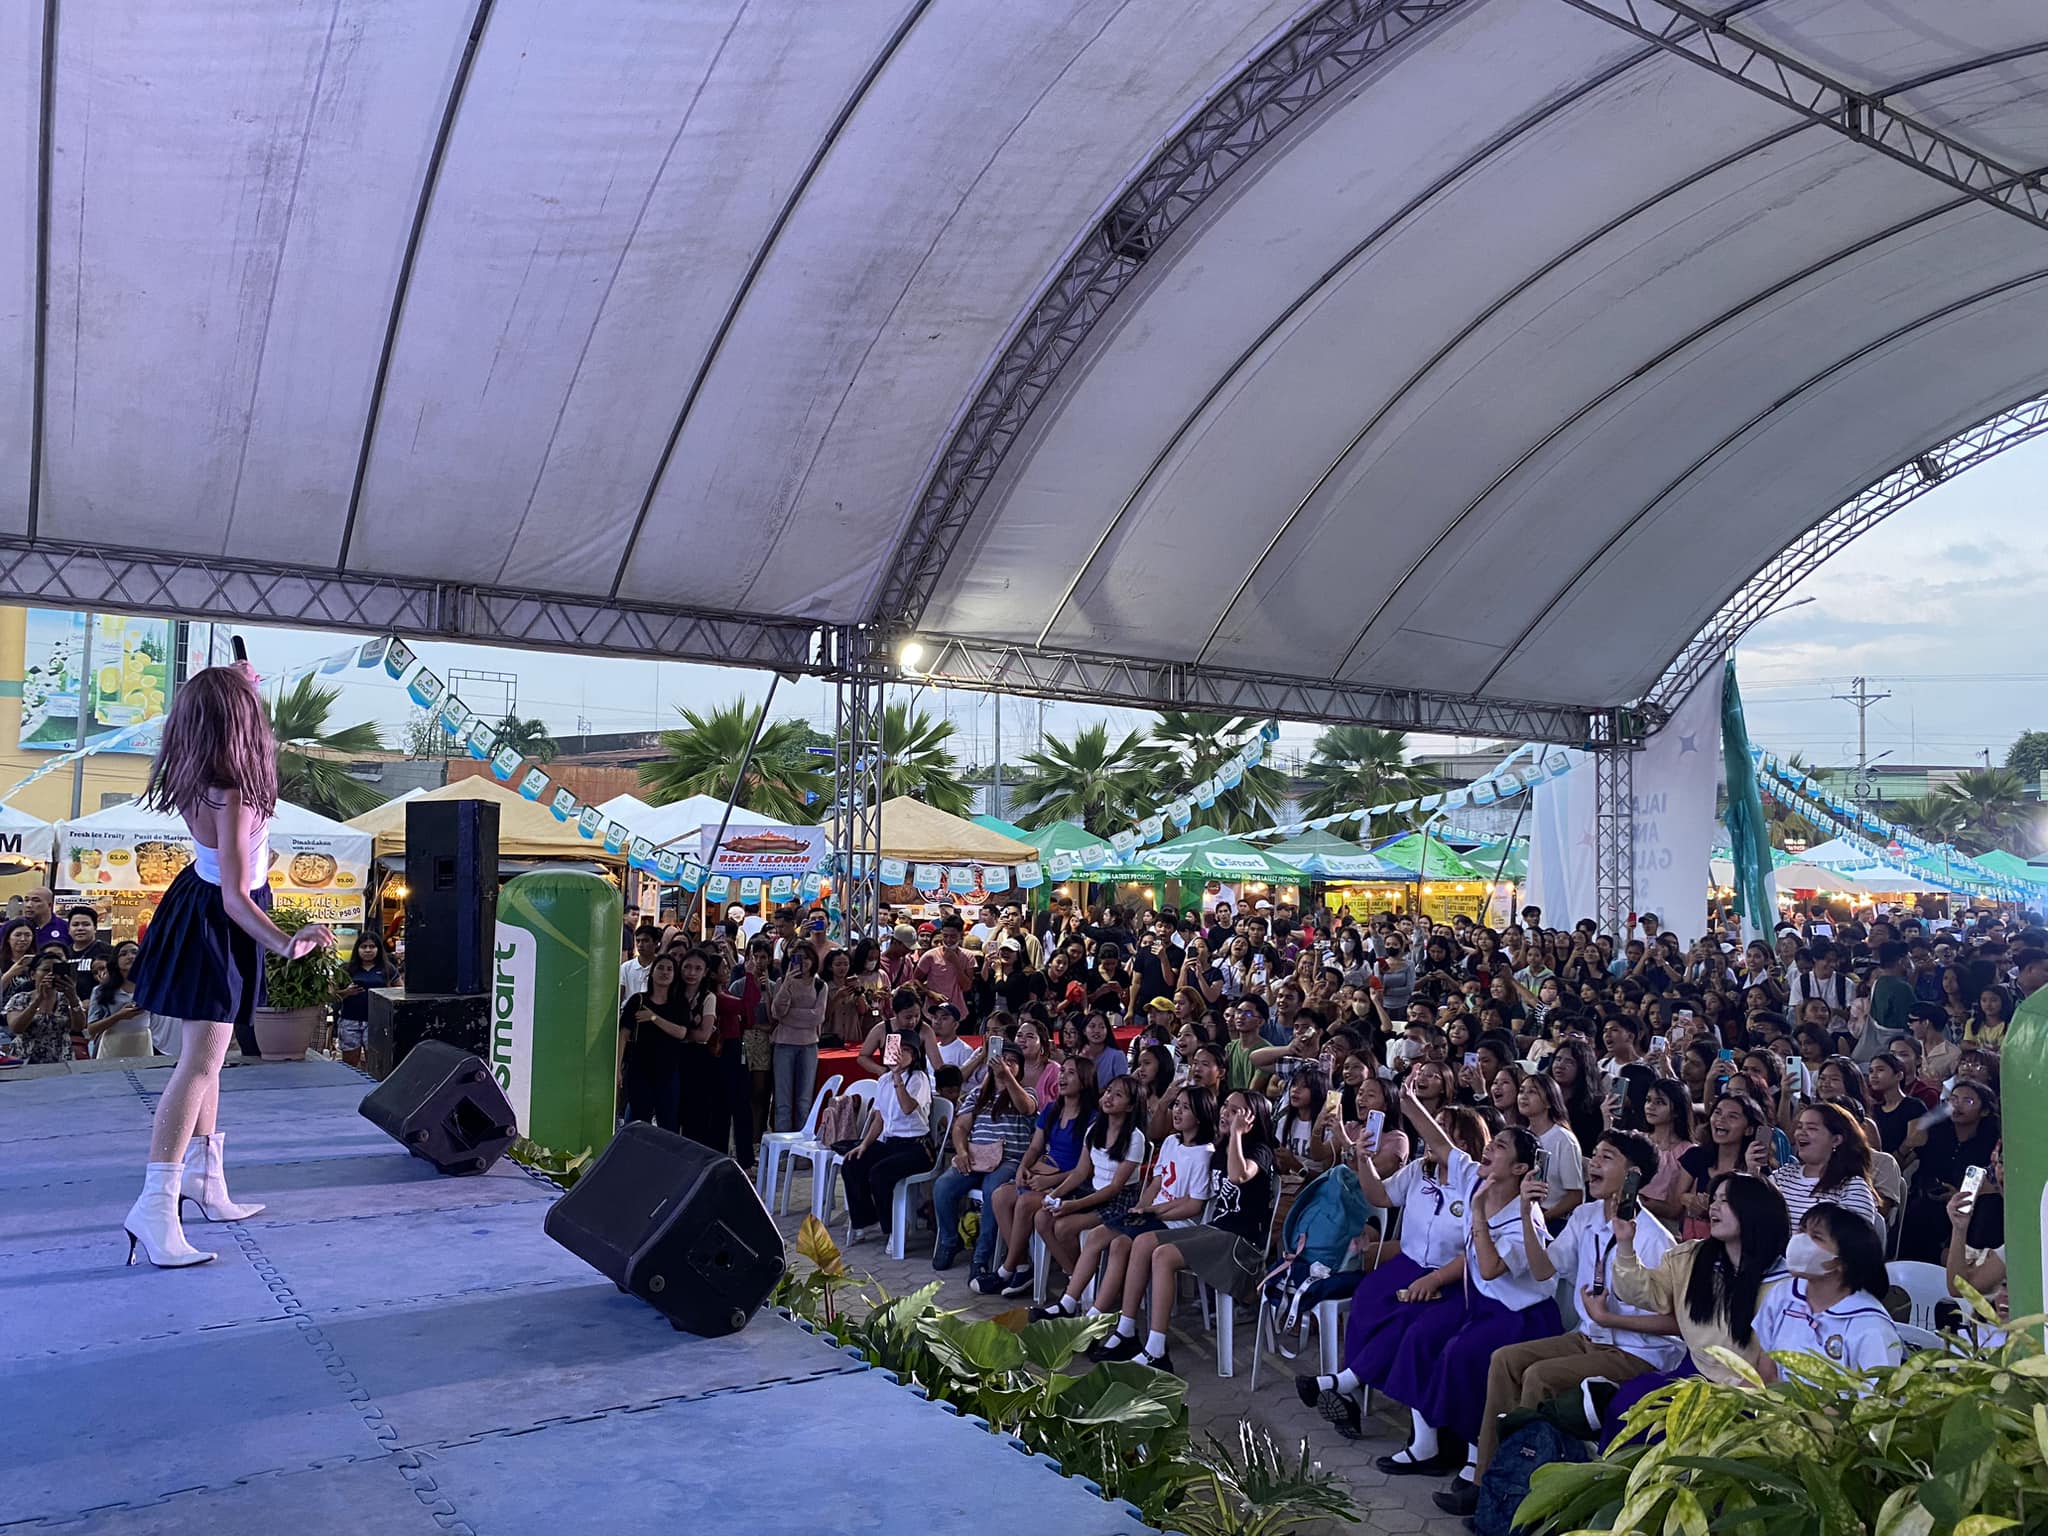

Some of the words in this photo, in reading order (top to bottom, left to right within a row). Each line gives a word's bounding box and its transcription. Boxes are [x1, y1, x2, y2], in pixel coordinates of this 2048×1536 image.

[390, 650, 404, 669] Smart
[416, 679, 434, 699] Smart
[446, 707, 460, 724] Smart
[474, 733, 490, 748] Smart
[500, 756, 513, 771] Smart
[526, 778, 540, 792] Smart
[556, 799, 569, 812] Smart
[582, 817, 595, 829] Smart
[608, 832, 620, 844] Smart
[632, 846, 646, 858] Smart
[718, 855, 754, 863] BENZ
[1225, 857, 1264, 867] Smart
[1338, 860, 1377, 869] Smart
[660, 860, 674, 871] Smart
[710, 884, 725, 892] Smart
[742, 886, 757, 895] Smart
[773, 885, 789, 894] Smart
[493, 941, 516, 1092] smart
